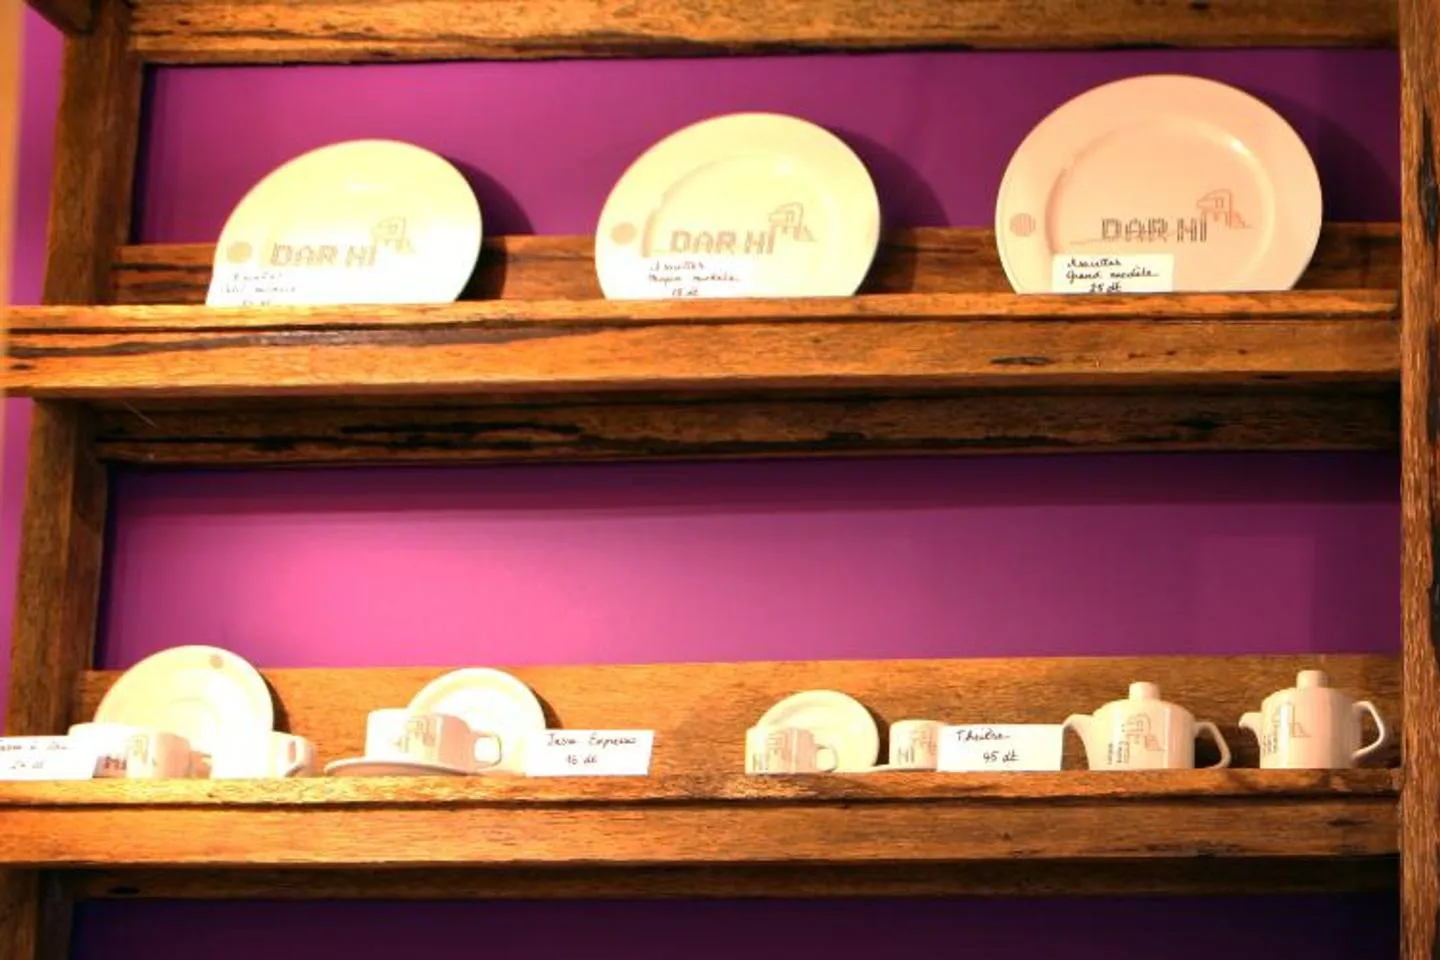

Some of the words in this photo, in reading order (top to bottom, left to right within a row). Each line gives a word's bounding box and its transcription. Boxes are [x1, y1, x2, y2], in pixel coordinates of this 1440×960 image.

[669, 230, 738, 254] DAR
[744, 229, 777, 255] HI
[1101, 218, 1170, 242] DAR
[1177, 217, 1207, 243] HI
[269, 244, 338, 267] DAR
